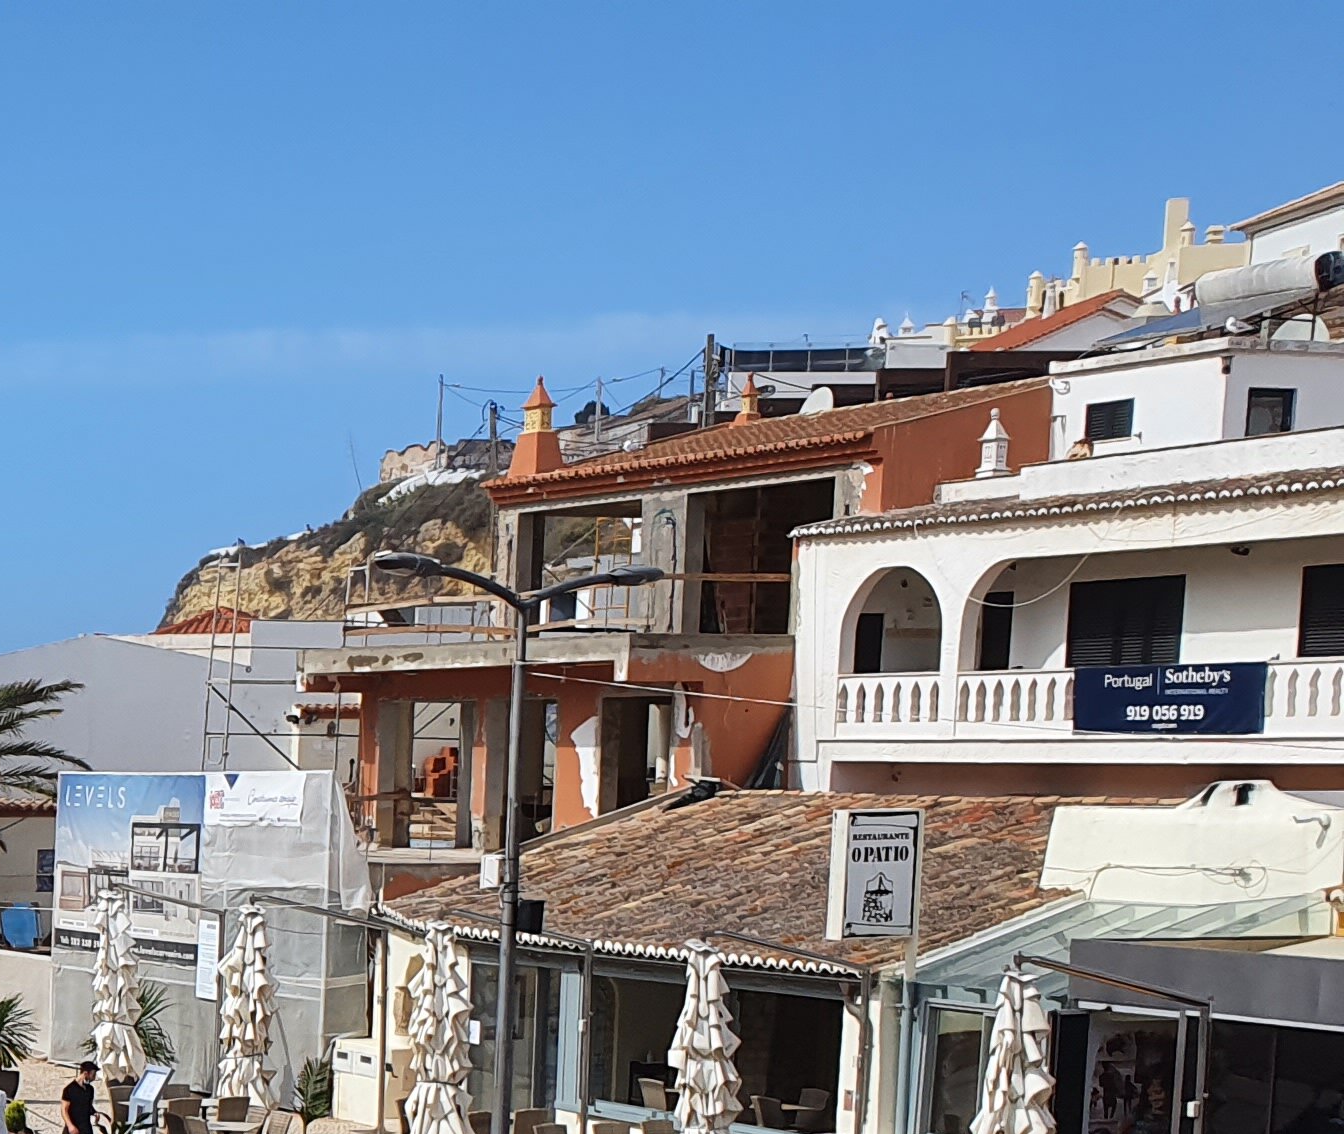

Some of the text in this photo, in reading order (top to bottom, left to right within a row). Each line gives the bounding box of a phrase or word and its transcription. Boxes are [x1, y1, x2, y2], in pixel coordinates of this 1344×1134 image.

[1104, 673, 1153, 690] Portugal
[1164, 666, 1231, 687] Sotheby's
[1126, 704, 1205, 721] 919 056 919
[65, 784, 126, 809] LEVELS
[852, 832, 910, 841] RESTAURANTE
[863, 846, 909, 863] PATIO
